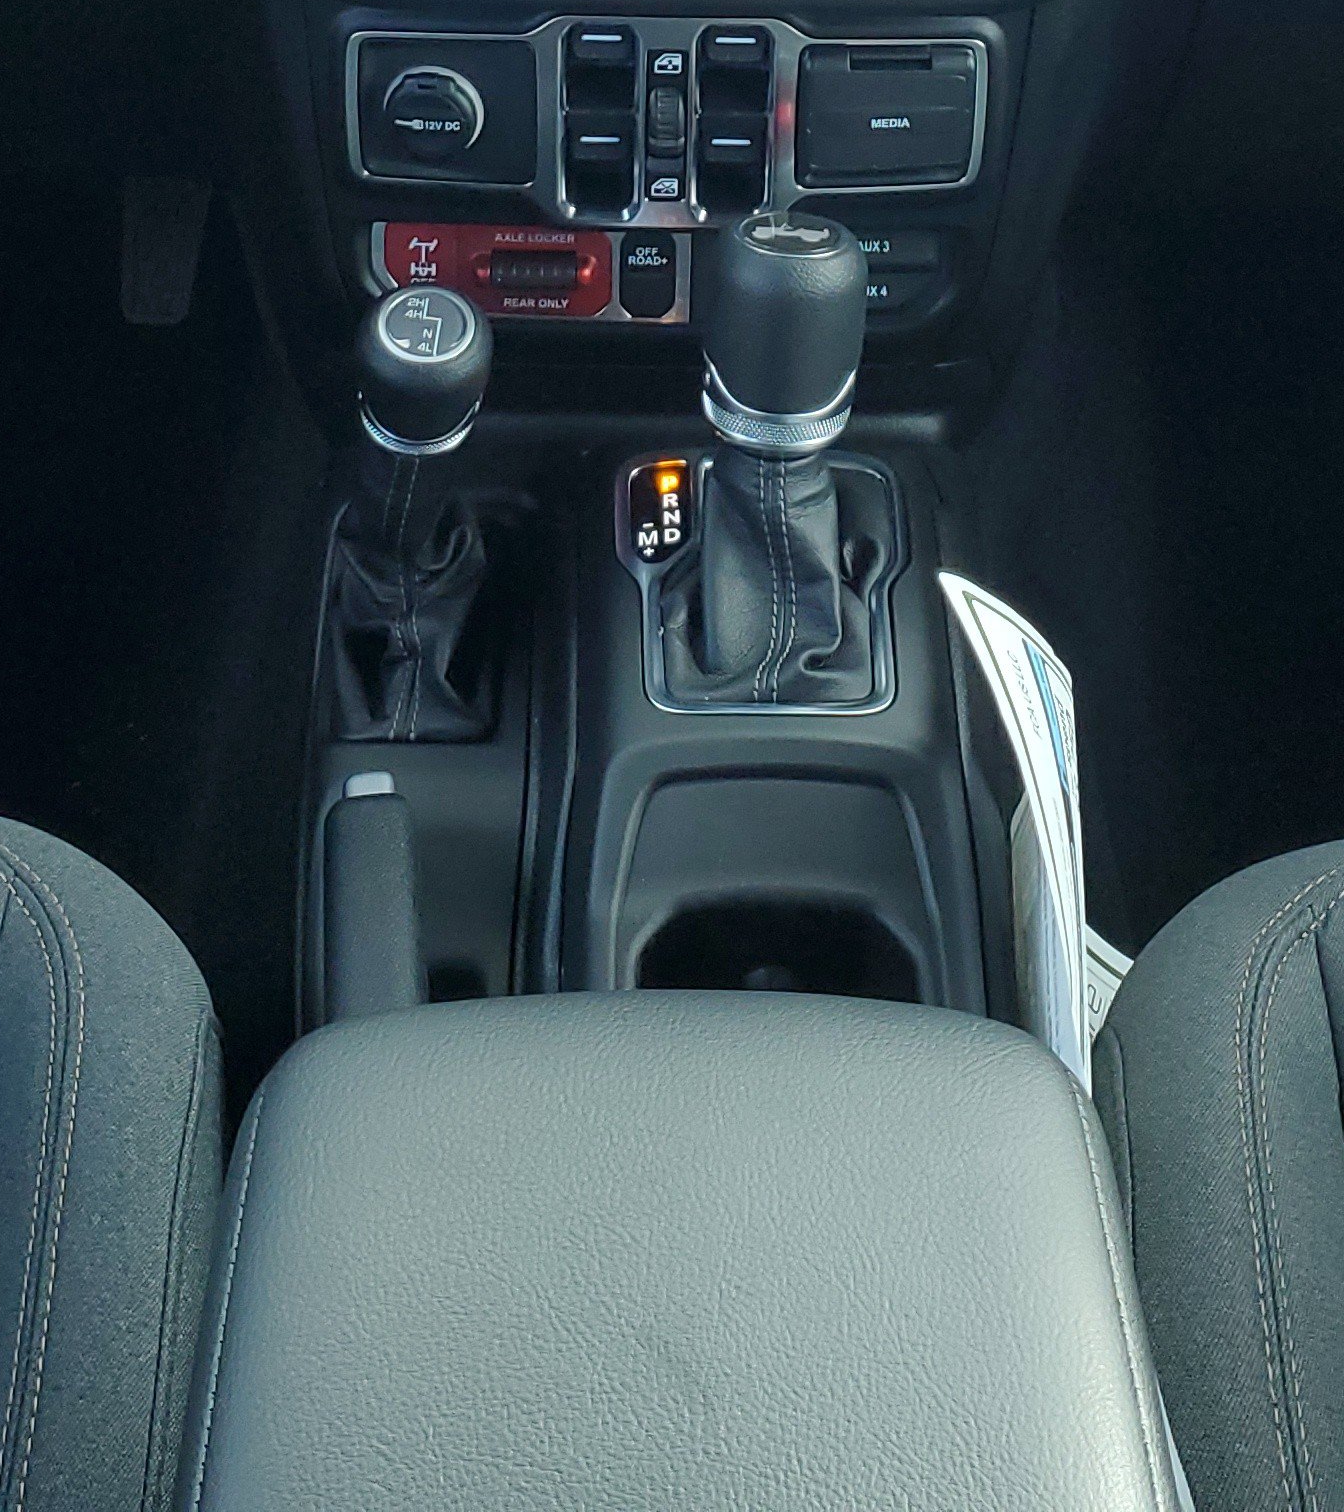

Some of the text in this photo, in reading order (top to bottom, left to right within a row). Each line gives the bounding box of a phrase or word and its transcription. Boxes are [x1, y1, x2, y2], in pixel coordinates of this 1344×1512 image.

[425, 120, 461, 131] 12V DC
[870, 117, 910, 129] MEDIA
[494, 233, 575, 244] AXLE LOCKER
[635, 247, 659, 256] OFF
[882, 240, 890, 253] 3
[880, 285, 888, 297] 4
[407, 297, 425, 307] 2H
[503, 297, 570, 309] REAR ONLY
[404, 309, 423, 318] 4H
[423, 328, 433, 338] N
[417, 342, 432, 352] 4L
[660, 474, 678, 494] P
[662, 493, 679, 508] R
[663, 509, 681, 526] N
[638, 530, 658, 548] M
[663, 528, 681, 544] D
